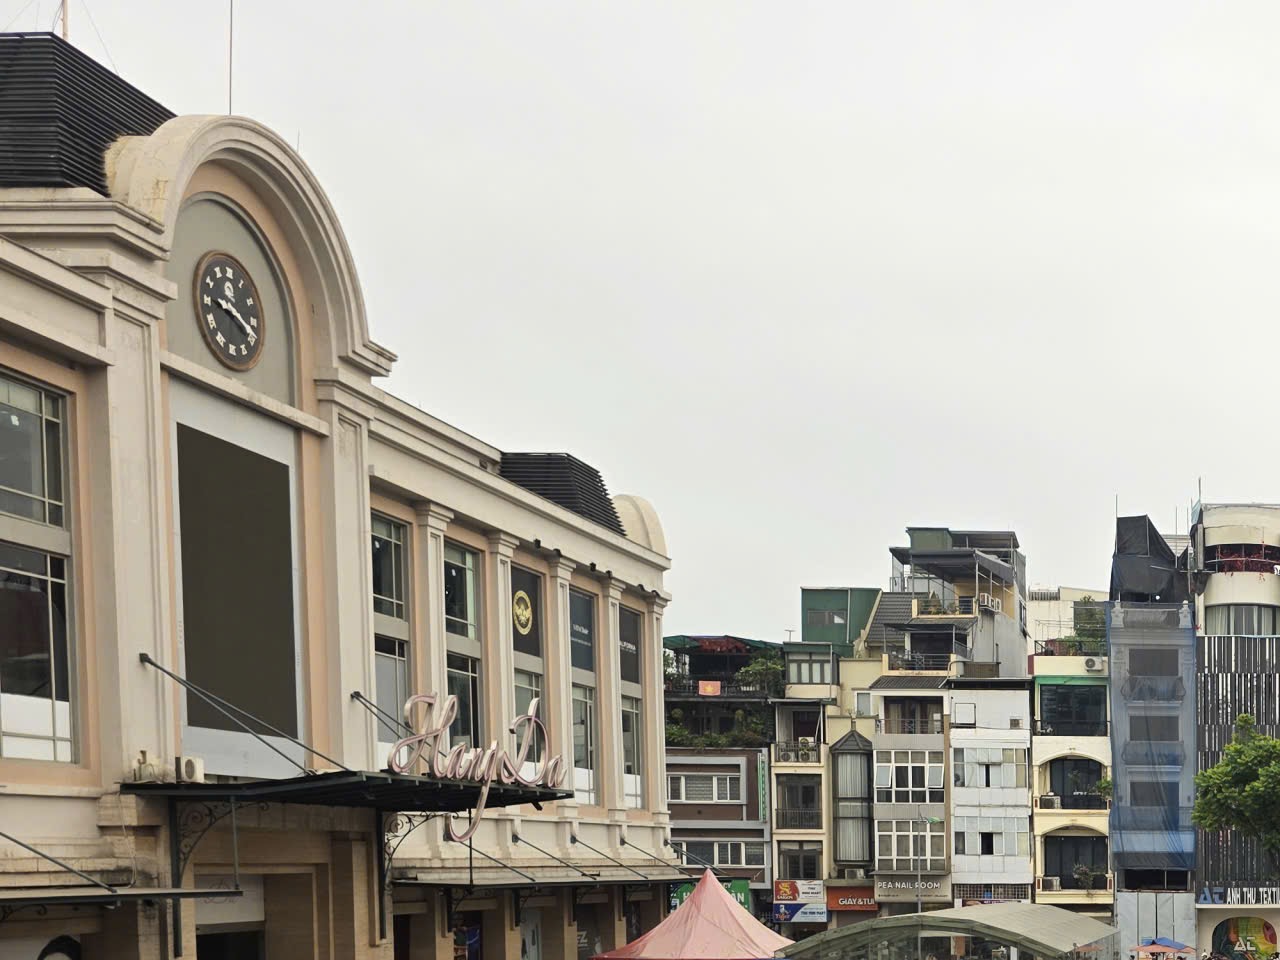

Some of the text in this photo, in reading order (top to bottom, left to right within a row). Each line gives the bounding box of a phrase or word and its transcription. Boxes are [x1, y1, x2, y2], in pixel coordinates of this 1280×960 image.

[387, 690, 499, 842] Hang
[877, 881, 893, 889] PEA
[895, 881, 913, 889] NAIL
[1226, 887, 1241, 904] ANH
[1243, 887, 1256, 904] THU
